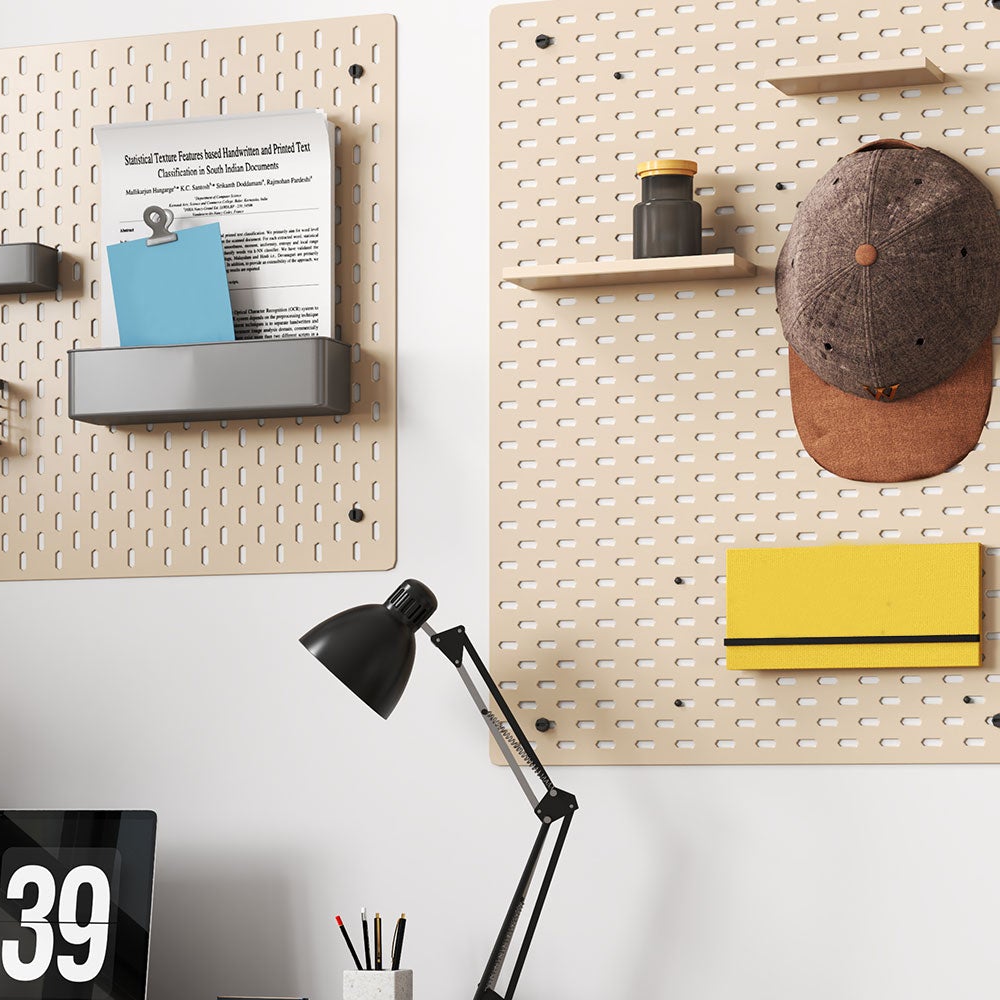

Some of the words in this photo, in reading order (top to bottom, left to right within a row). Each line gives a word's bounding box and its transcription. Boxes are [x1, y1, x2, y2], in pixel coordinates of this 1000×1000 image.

[125, 153, 153, 166] Statistical
[155, 151, 177, 163] Texture
[179, 149, 204, 162] Features
[205, 148, 222, 160] based
[224, 145, 260, 158] Handwritten
[261, 144, 272, 155] and
[274, 142, 295, 154] Printed
[297, 141, 311, 153] Text
[158, 166, 198, 178] Classification
[199, 165, 205, 175] in
[206, 164, 224, 175] South
[225, 162, 244, 173] Indian
[246, 160, 280, 172] Documents
[1, 864, 111, 983] 39
